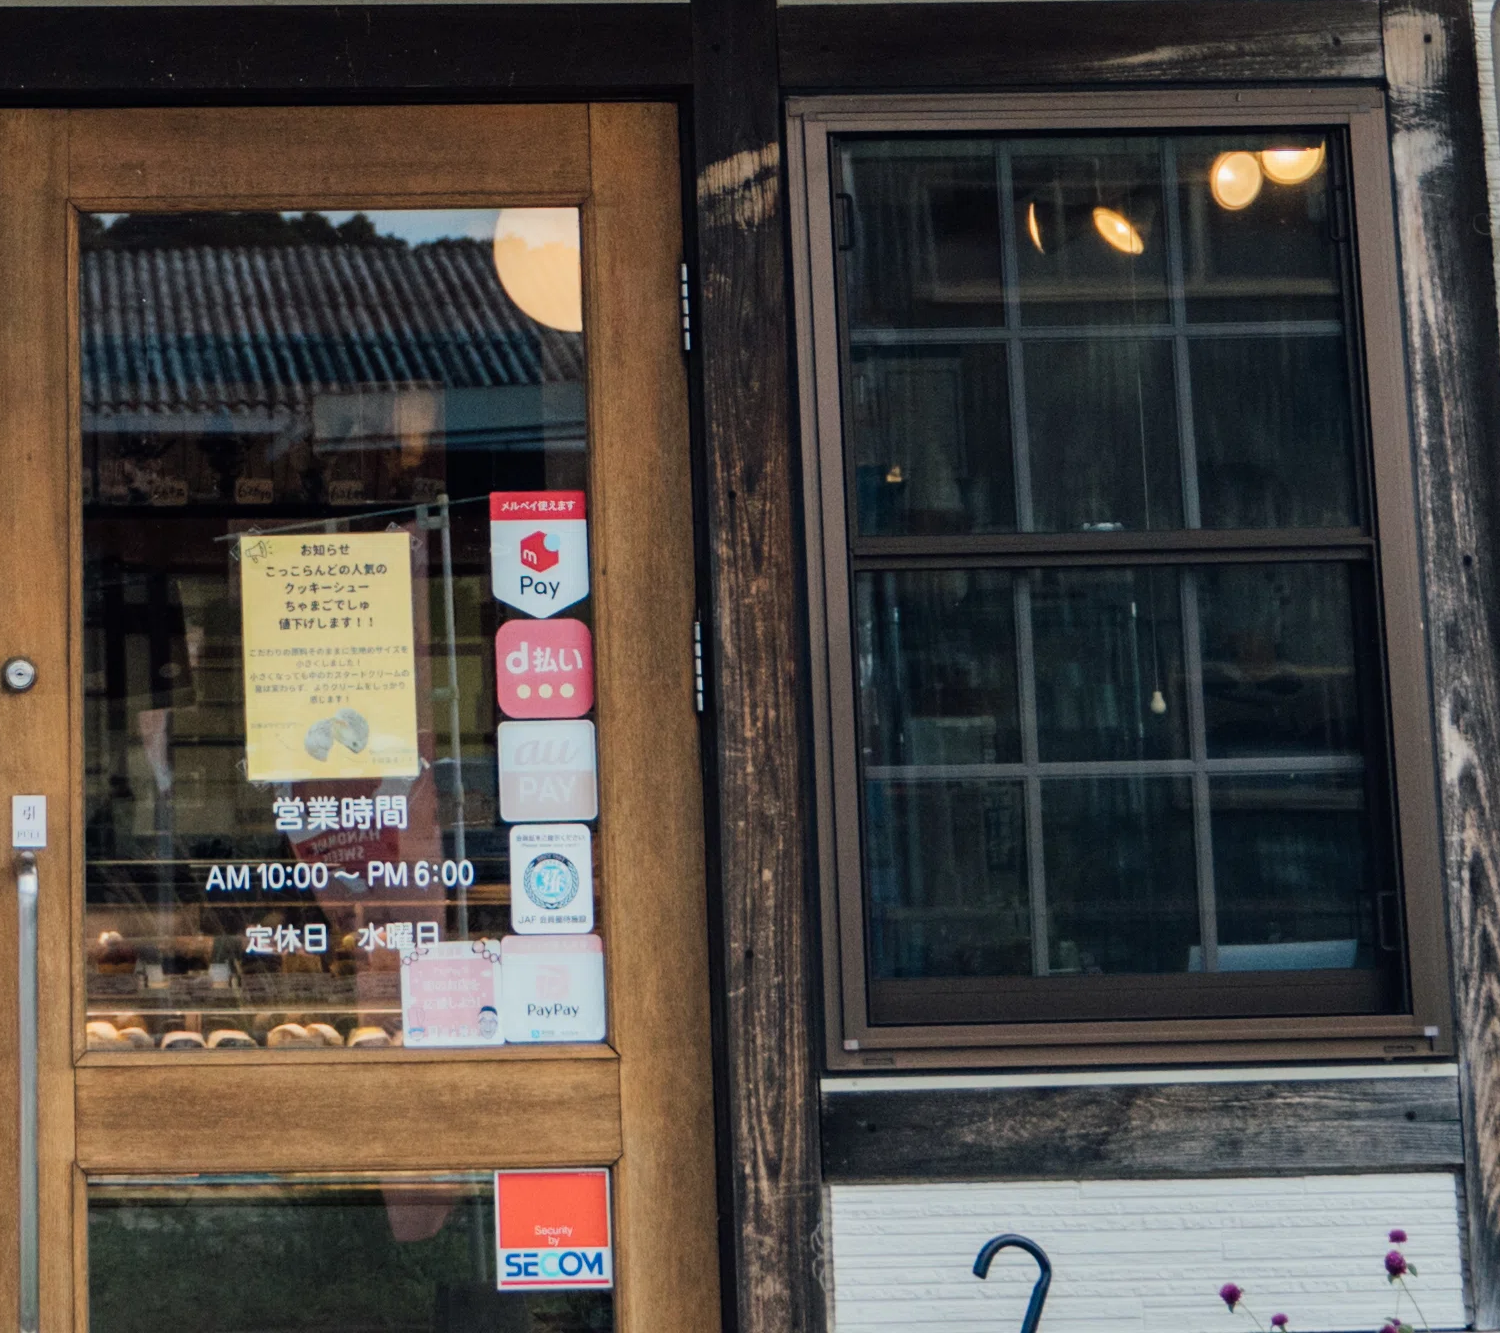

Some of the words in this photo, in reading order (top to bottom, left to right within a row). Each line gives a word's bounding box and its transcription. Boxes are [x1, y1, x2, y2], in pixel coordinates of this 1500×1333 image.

[501, 500, 576, 512] メルペイ使えます
[300, 543, 351, 557] お知らせ
[265, 563, 388, 578] こっこらんどの人気の
[284, 582, 370, 595] クッキーシュー
[520, 575, 560, 600] Pay
[285, 599, 370, 612] ちゃまごでしゅ
[505, 641, 583, 675] d払い
[519, 775, 577, 803] PAY
[272, 794, 408, 831] 営業時間
[205, 864, 250, 891] AM
[256, 862, 329, 889] 10:00
[367, 860, 408, 887] PM
[413, 858, 475, 887] 6:00
[245, 923, 328, 954] 定休日
[357, 921, 439, 950] 水曜日
[527, 1004, 580, 1018] PayPay
[534, 1225, 574, 1237] Security
[547, 1236, 560, 1247] by
[505, 1250, 604, 1278] SECOM
